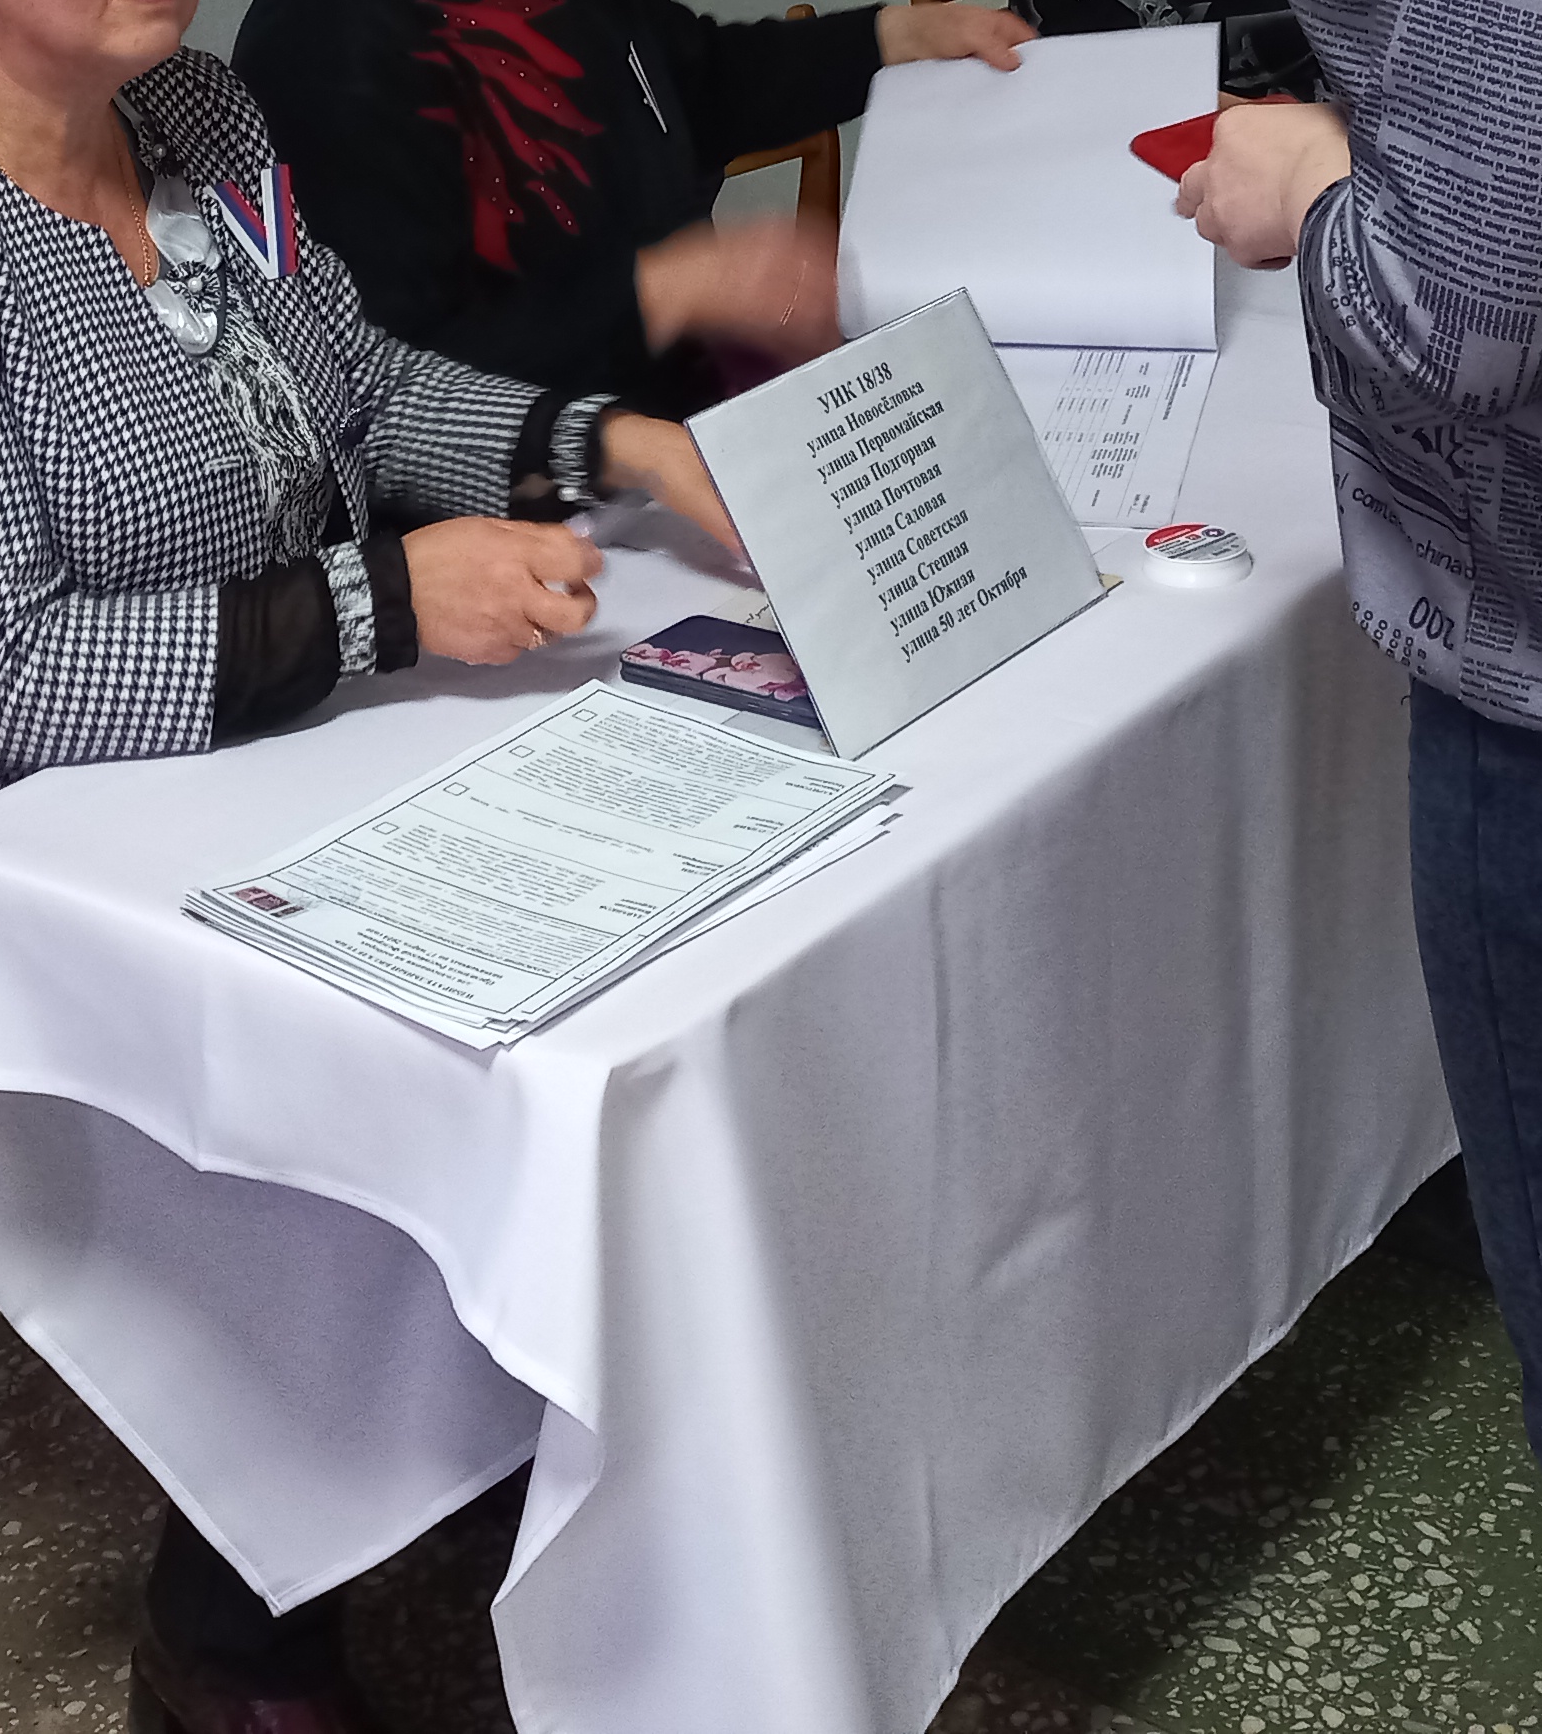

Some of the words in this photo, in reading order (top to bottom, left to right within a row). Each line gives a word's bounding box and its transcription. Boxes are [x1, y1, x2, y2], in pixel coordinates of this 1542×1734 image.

[806, 424, 847, 458] улица
[844, 381, 925, 432] Новосёловка
[817, 380, 857, 414] УИК
[856, 362, 892, 394] 18/38
[817, 449, 858, 484] улица
[855, 400, 945, 457] Первомайская
[830, 473, 871, 509] улица
[868, 435, 937, 481] Подгорная
[843, 498, 884, 534] улица
[881, 463, 942, 507] Почтовая
[855, 524, 895, 560] улица
[894, 492, 947, 530] Садовая
[866, 548, 907, 585] улица
[906, 509, 969, 555] Советская
[878, 574, 918, 611] улица
[917, 540, 970, 581] Степная
[890, 600, 929, 637] улица
[926, 569, 976, 608] Южная
[901, 624, 940, 663] улица
[938, 610, 955, 633] 50
[956, 598, 977, 623] лет
[976, 566, 1028, 607] Октября
